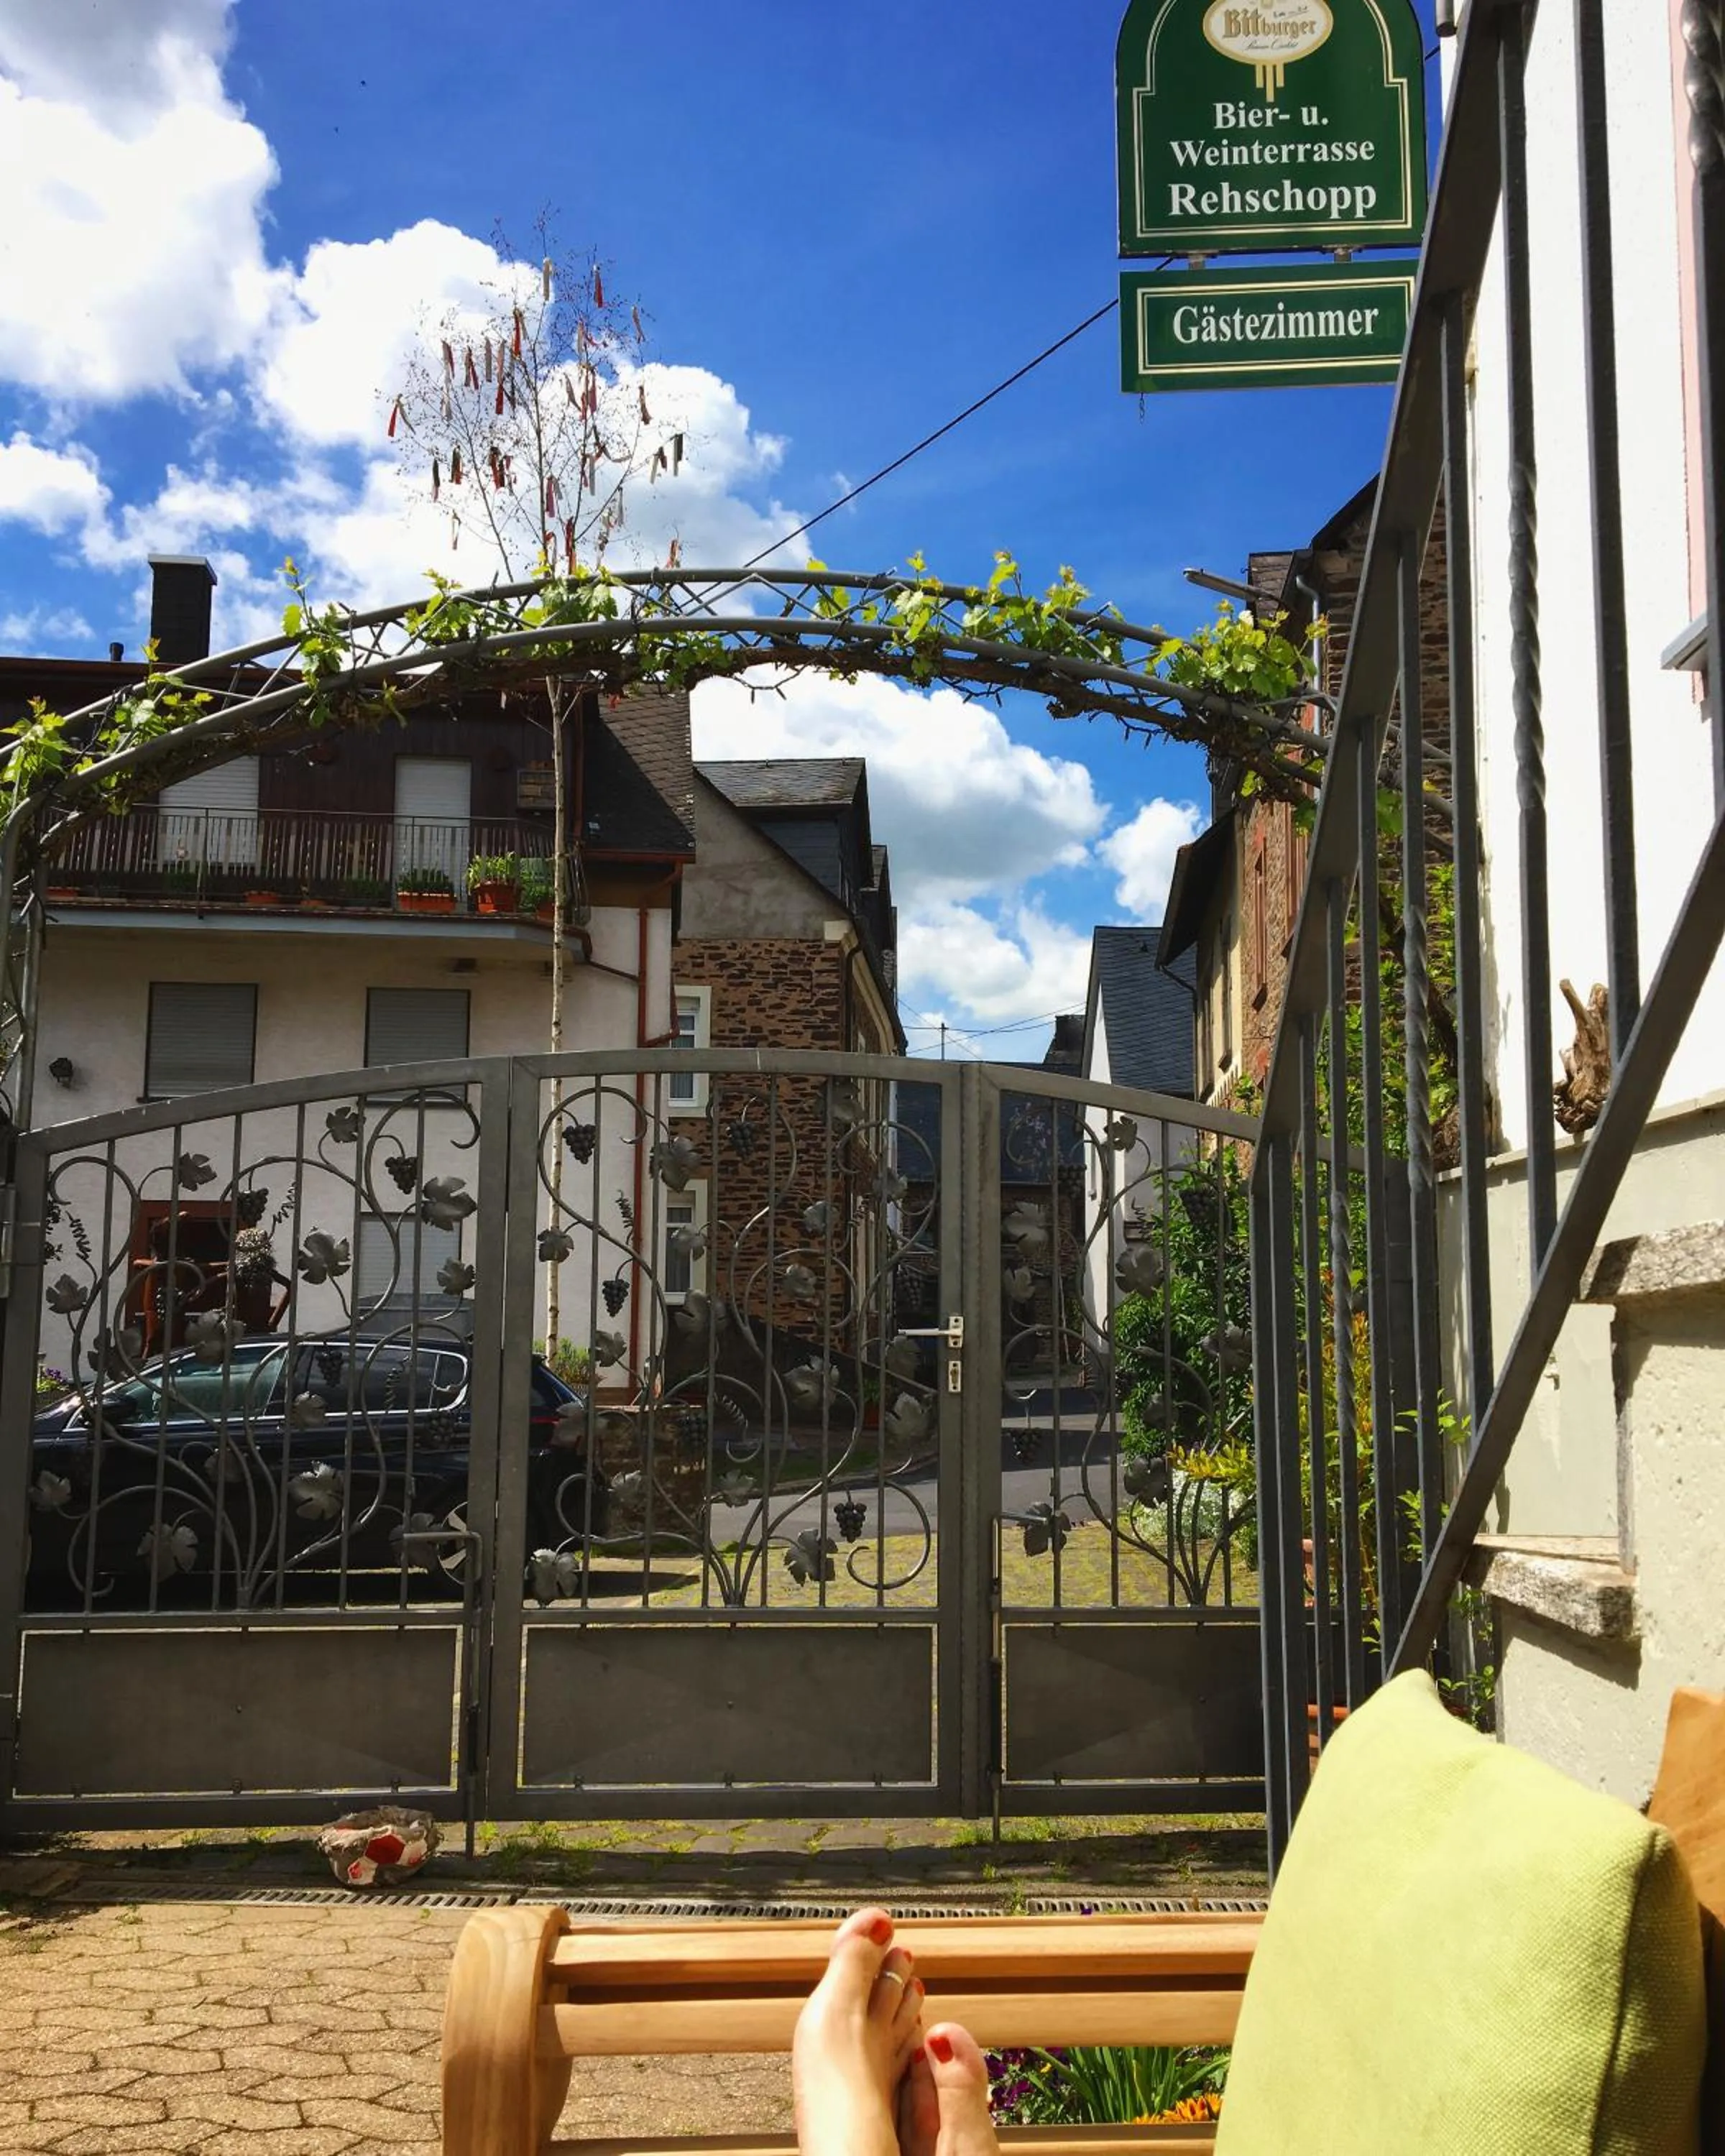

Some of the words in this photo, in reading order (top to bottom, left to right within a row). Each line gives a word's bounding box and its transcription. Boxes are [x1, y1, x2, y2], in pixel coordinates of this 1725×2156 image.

[1223, 8, 1317, 39] Bitburger
[1213, 101, 1290, 130] Bier-
[1301, 107, 1328, 126] u.
[1170, 139, 1376, 167] Weinterrasse
[1168, 180, 1377, 219] Rehschopp
[1173, 302, 1379, 344] Gästezimmer
